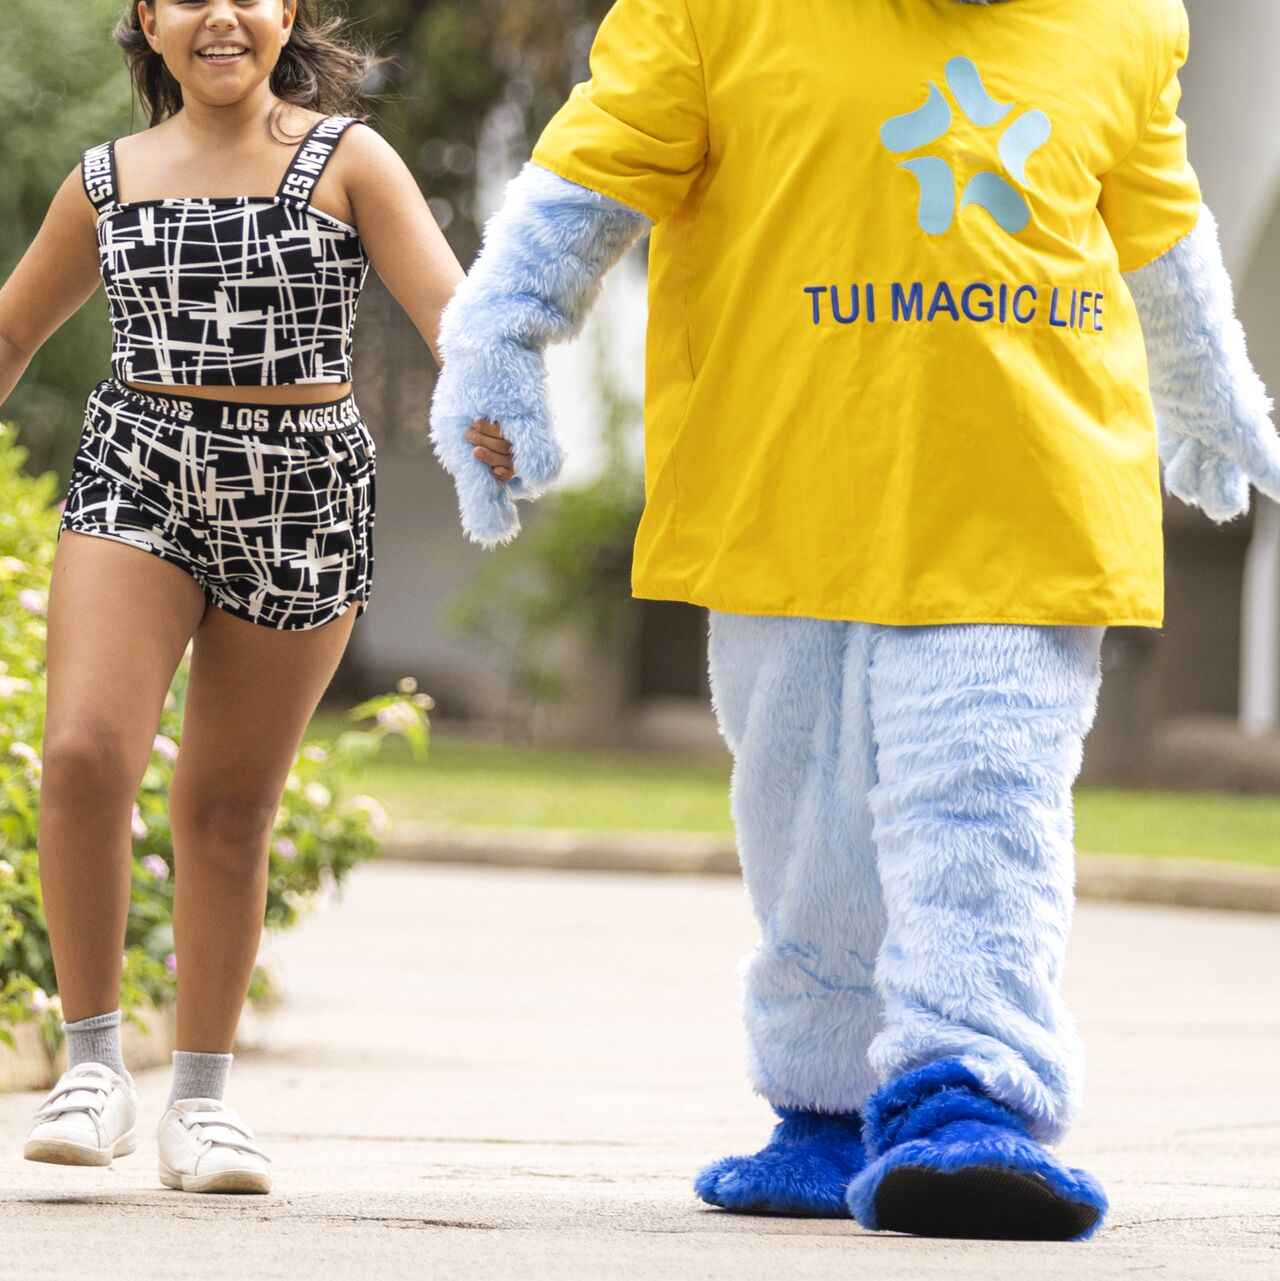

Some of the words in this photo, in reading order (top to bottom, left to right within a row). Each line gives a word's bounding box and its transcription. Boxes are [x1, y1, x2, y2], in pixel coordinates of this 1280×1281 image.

[312, 115, 354, 139] YOR
[84, 141, 113, 203] NGELES
[293, 139, 333, 176] NEW
[282, 173, 315, 203] ES
[803, 282, 875, 325] TUI
[891, 281, 1038, 324] MAGIC
[1049, 286, 1105, 332] LIFE
[220, 406, 270, 432] LOS
[278, 398, 359, 433] ANGELES
